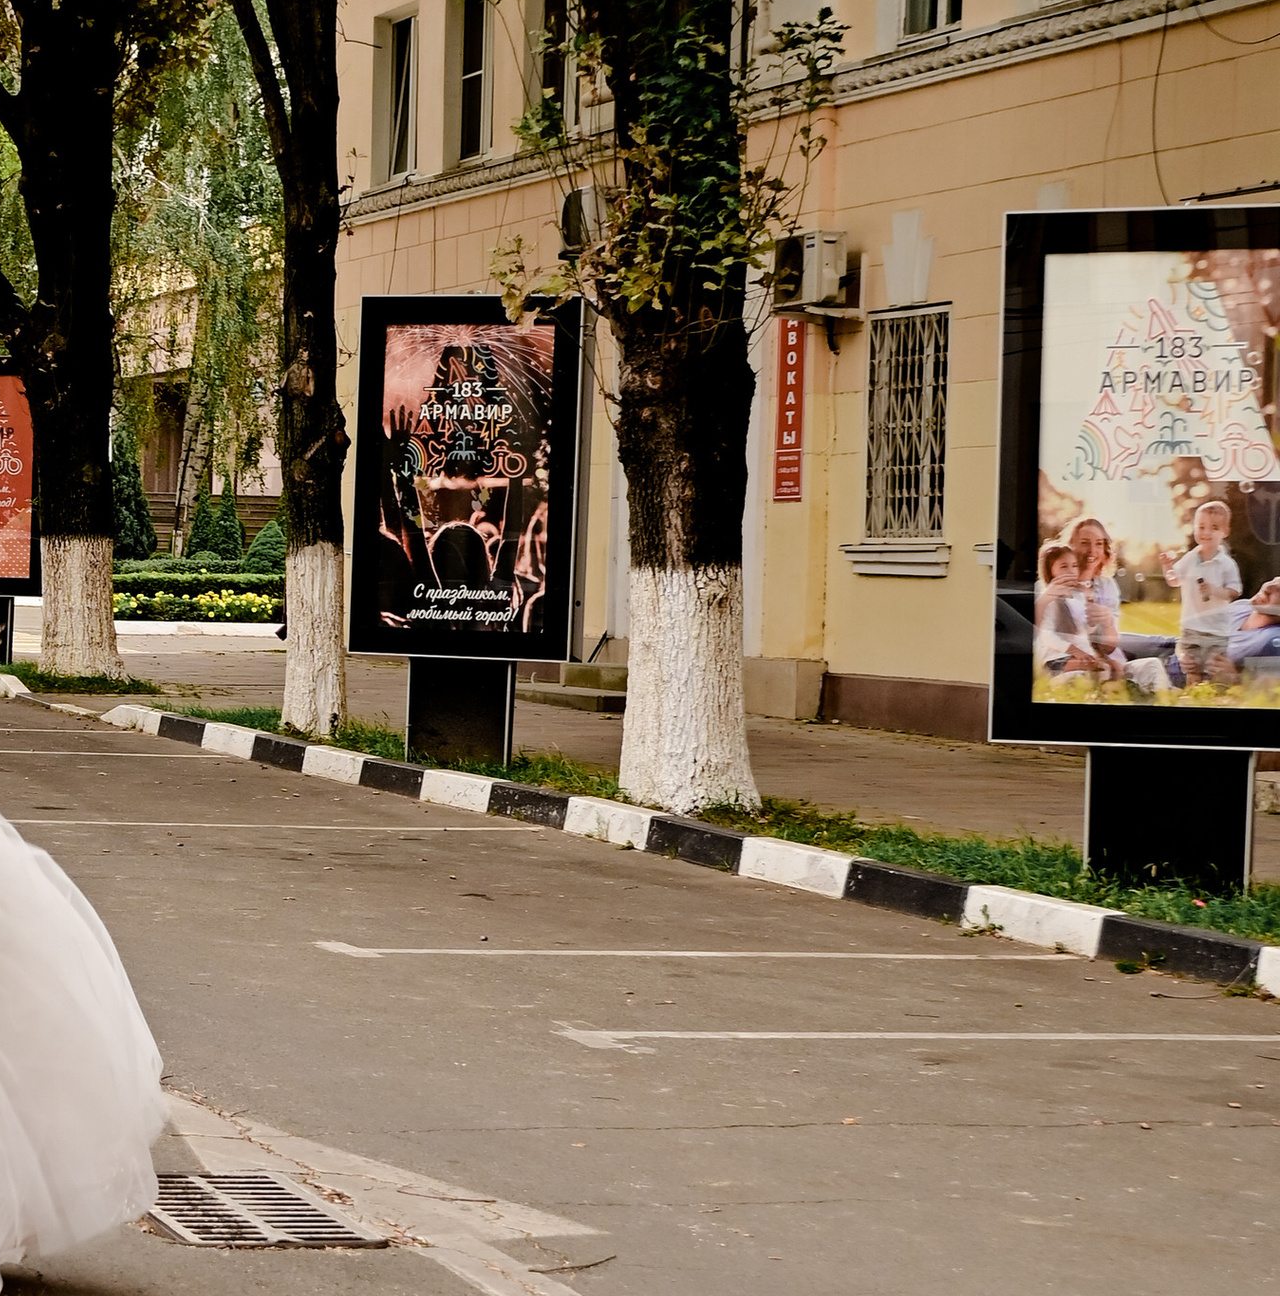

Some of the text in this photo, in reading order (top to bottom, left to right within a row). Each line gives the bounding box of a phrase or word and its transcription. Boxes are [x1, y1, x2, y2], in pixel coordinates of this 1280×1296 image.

[1155, 336, 1203, 359] 183
[452, 382, 483, 398] 183
[1099, 370, 1254, 393] АРМАВИР
[419, 404, 513, 420] АРМАВИР
[413, 583, 425, 598] С
[406, 605, 519, 626] любимый город!
